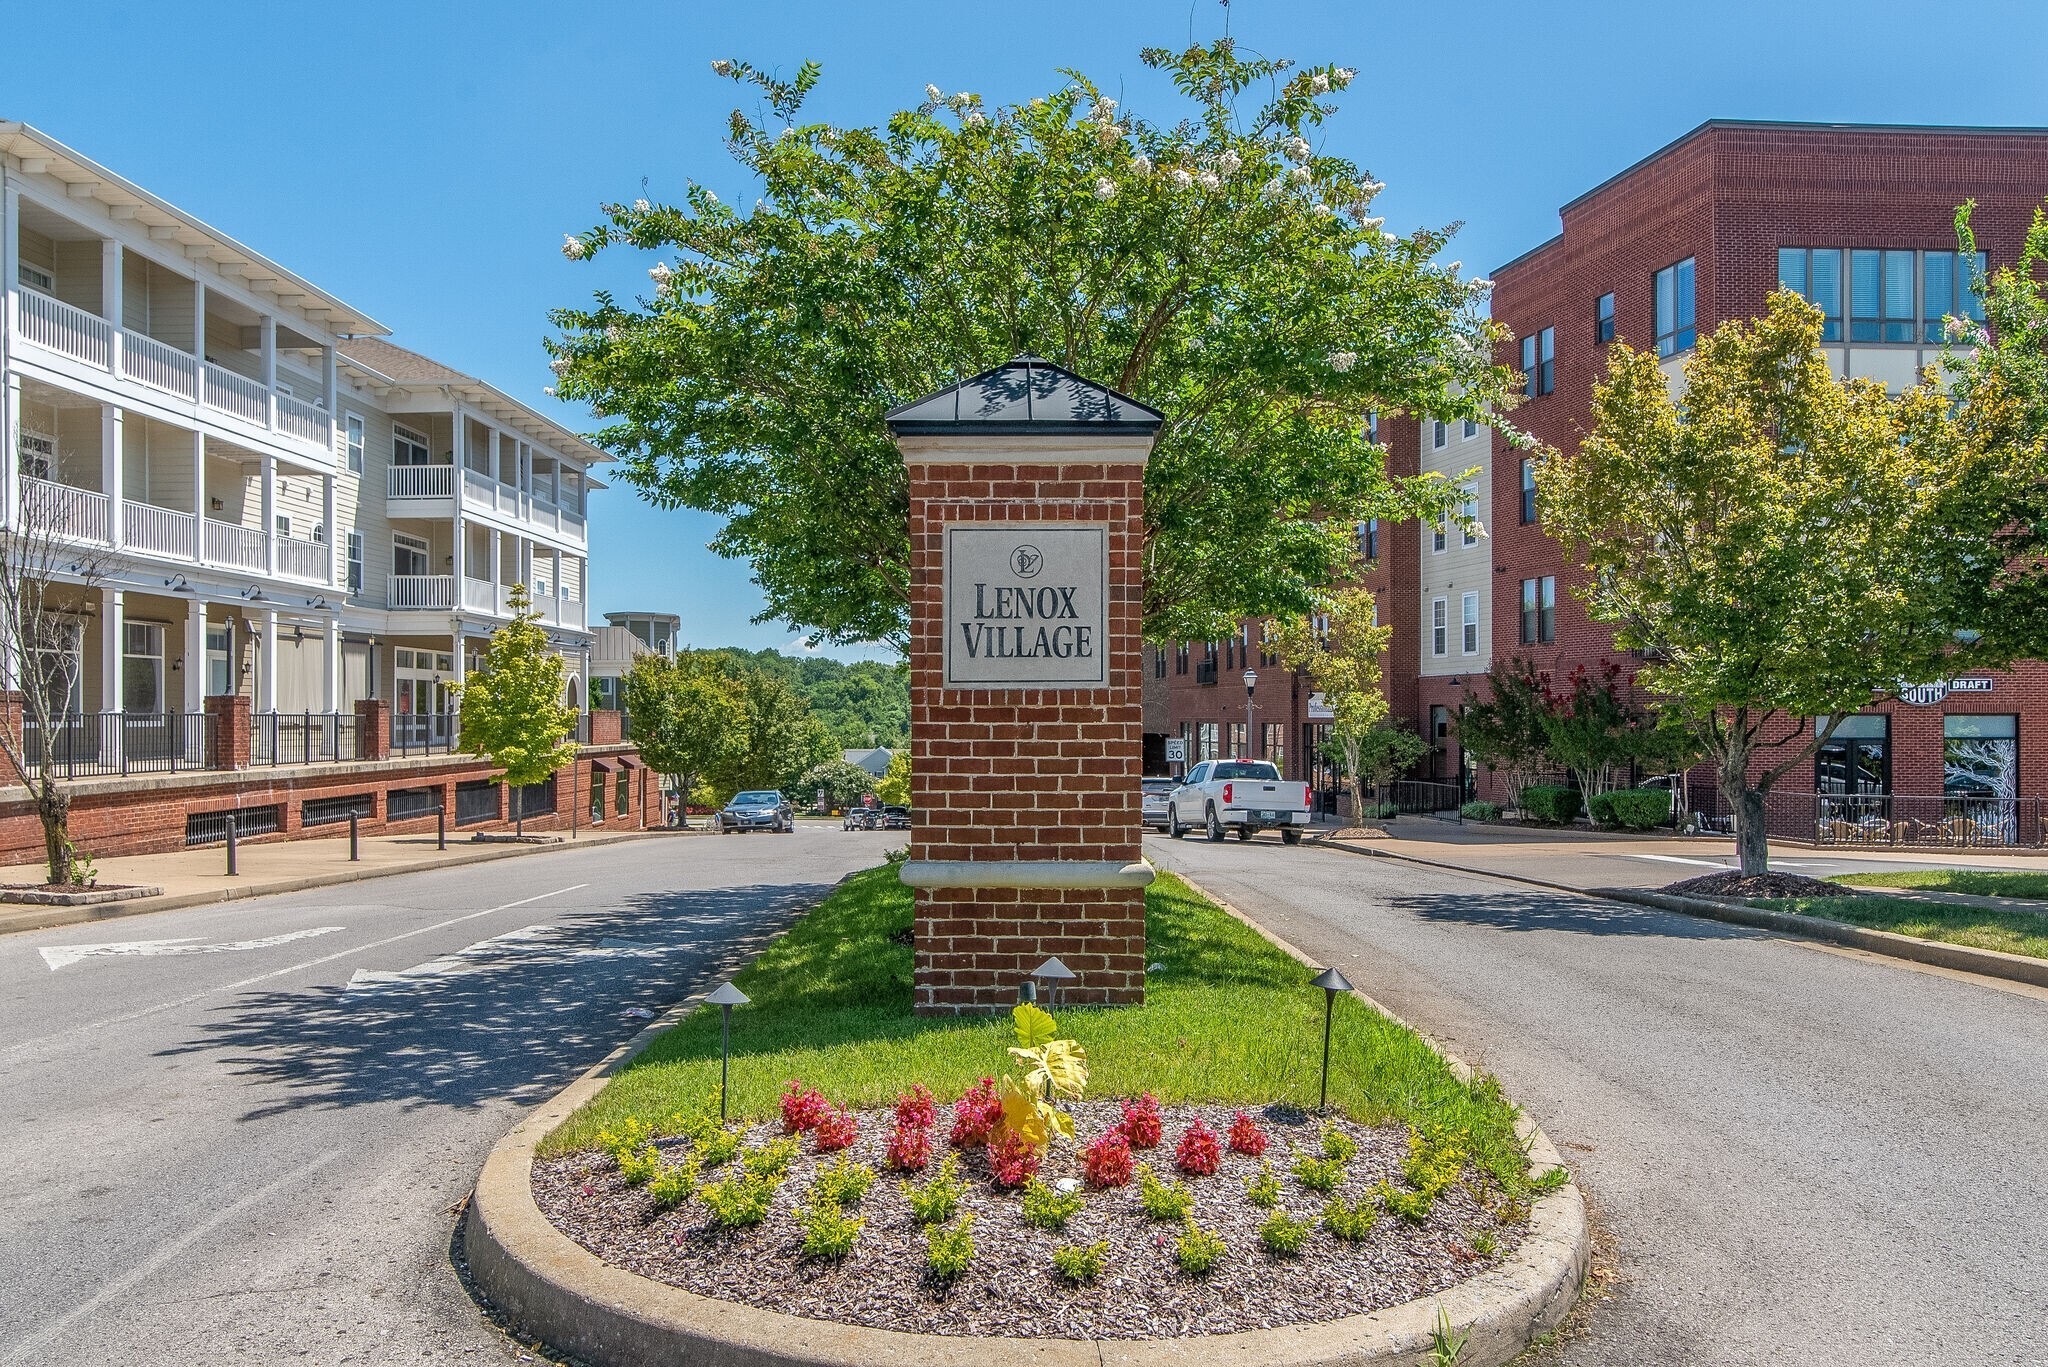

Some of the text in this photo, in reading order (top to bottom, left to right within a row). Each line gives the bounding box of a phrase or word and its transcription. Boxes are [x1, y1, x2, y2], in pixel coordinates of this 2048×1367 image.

[974, 583, 1079, 619] LENOX
[961, 622, 1093, 659] VILLAGE
[1952, 680, 1988, 689] DRAFT
[1901, 687, 1943, 703] SOUTH
[1168, 750, 1183, 759] 30
